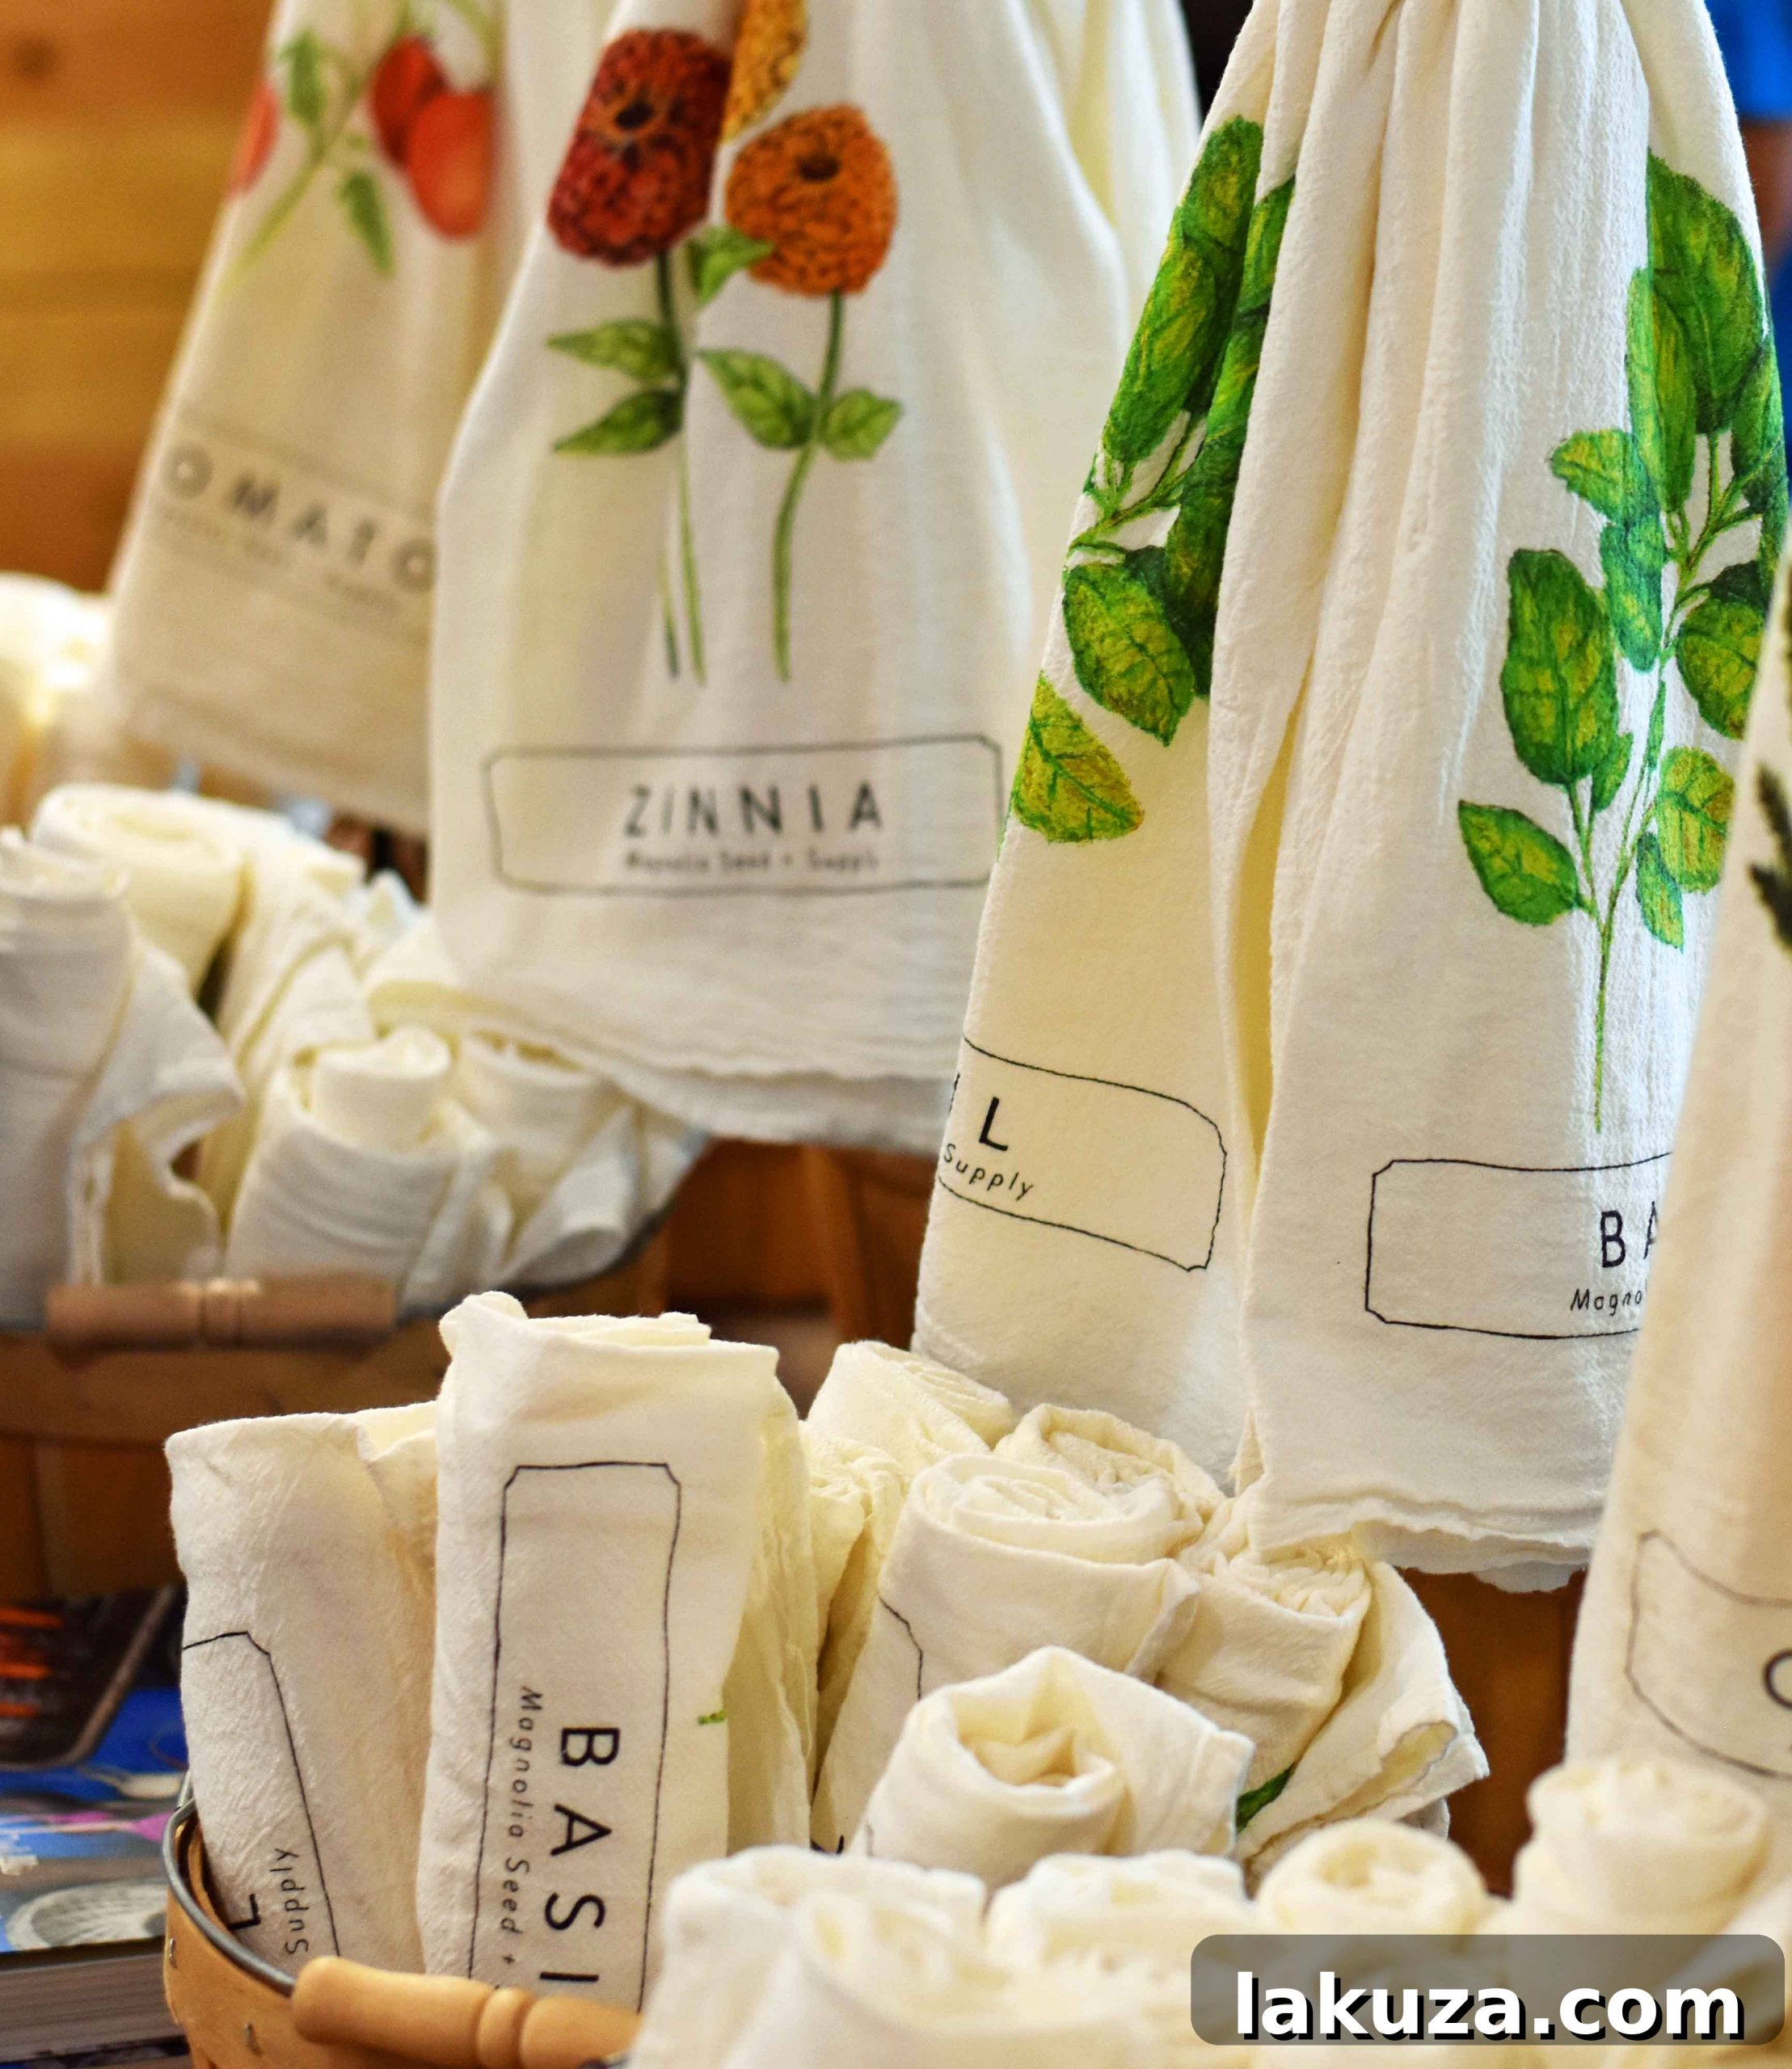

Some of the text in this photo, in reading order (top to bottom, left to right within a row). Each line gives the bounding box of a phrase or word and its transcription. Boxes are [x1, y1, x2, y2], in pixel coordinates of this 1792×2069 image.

[624, 780, 882, 836] ZINNIA
[942, 1143, 1034, 1201] Supply
[508, 1684, 543, 1839] Magnolia
[500, 1856, 530, 1935] Seed
[538, 1726, 621, 1983] BASI
[268, 1848, 311, 1955] Supply
